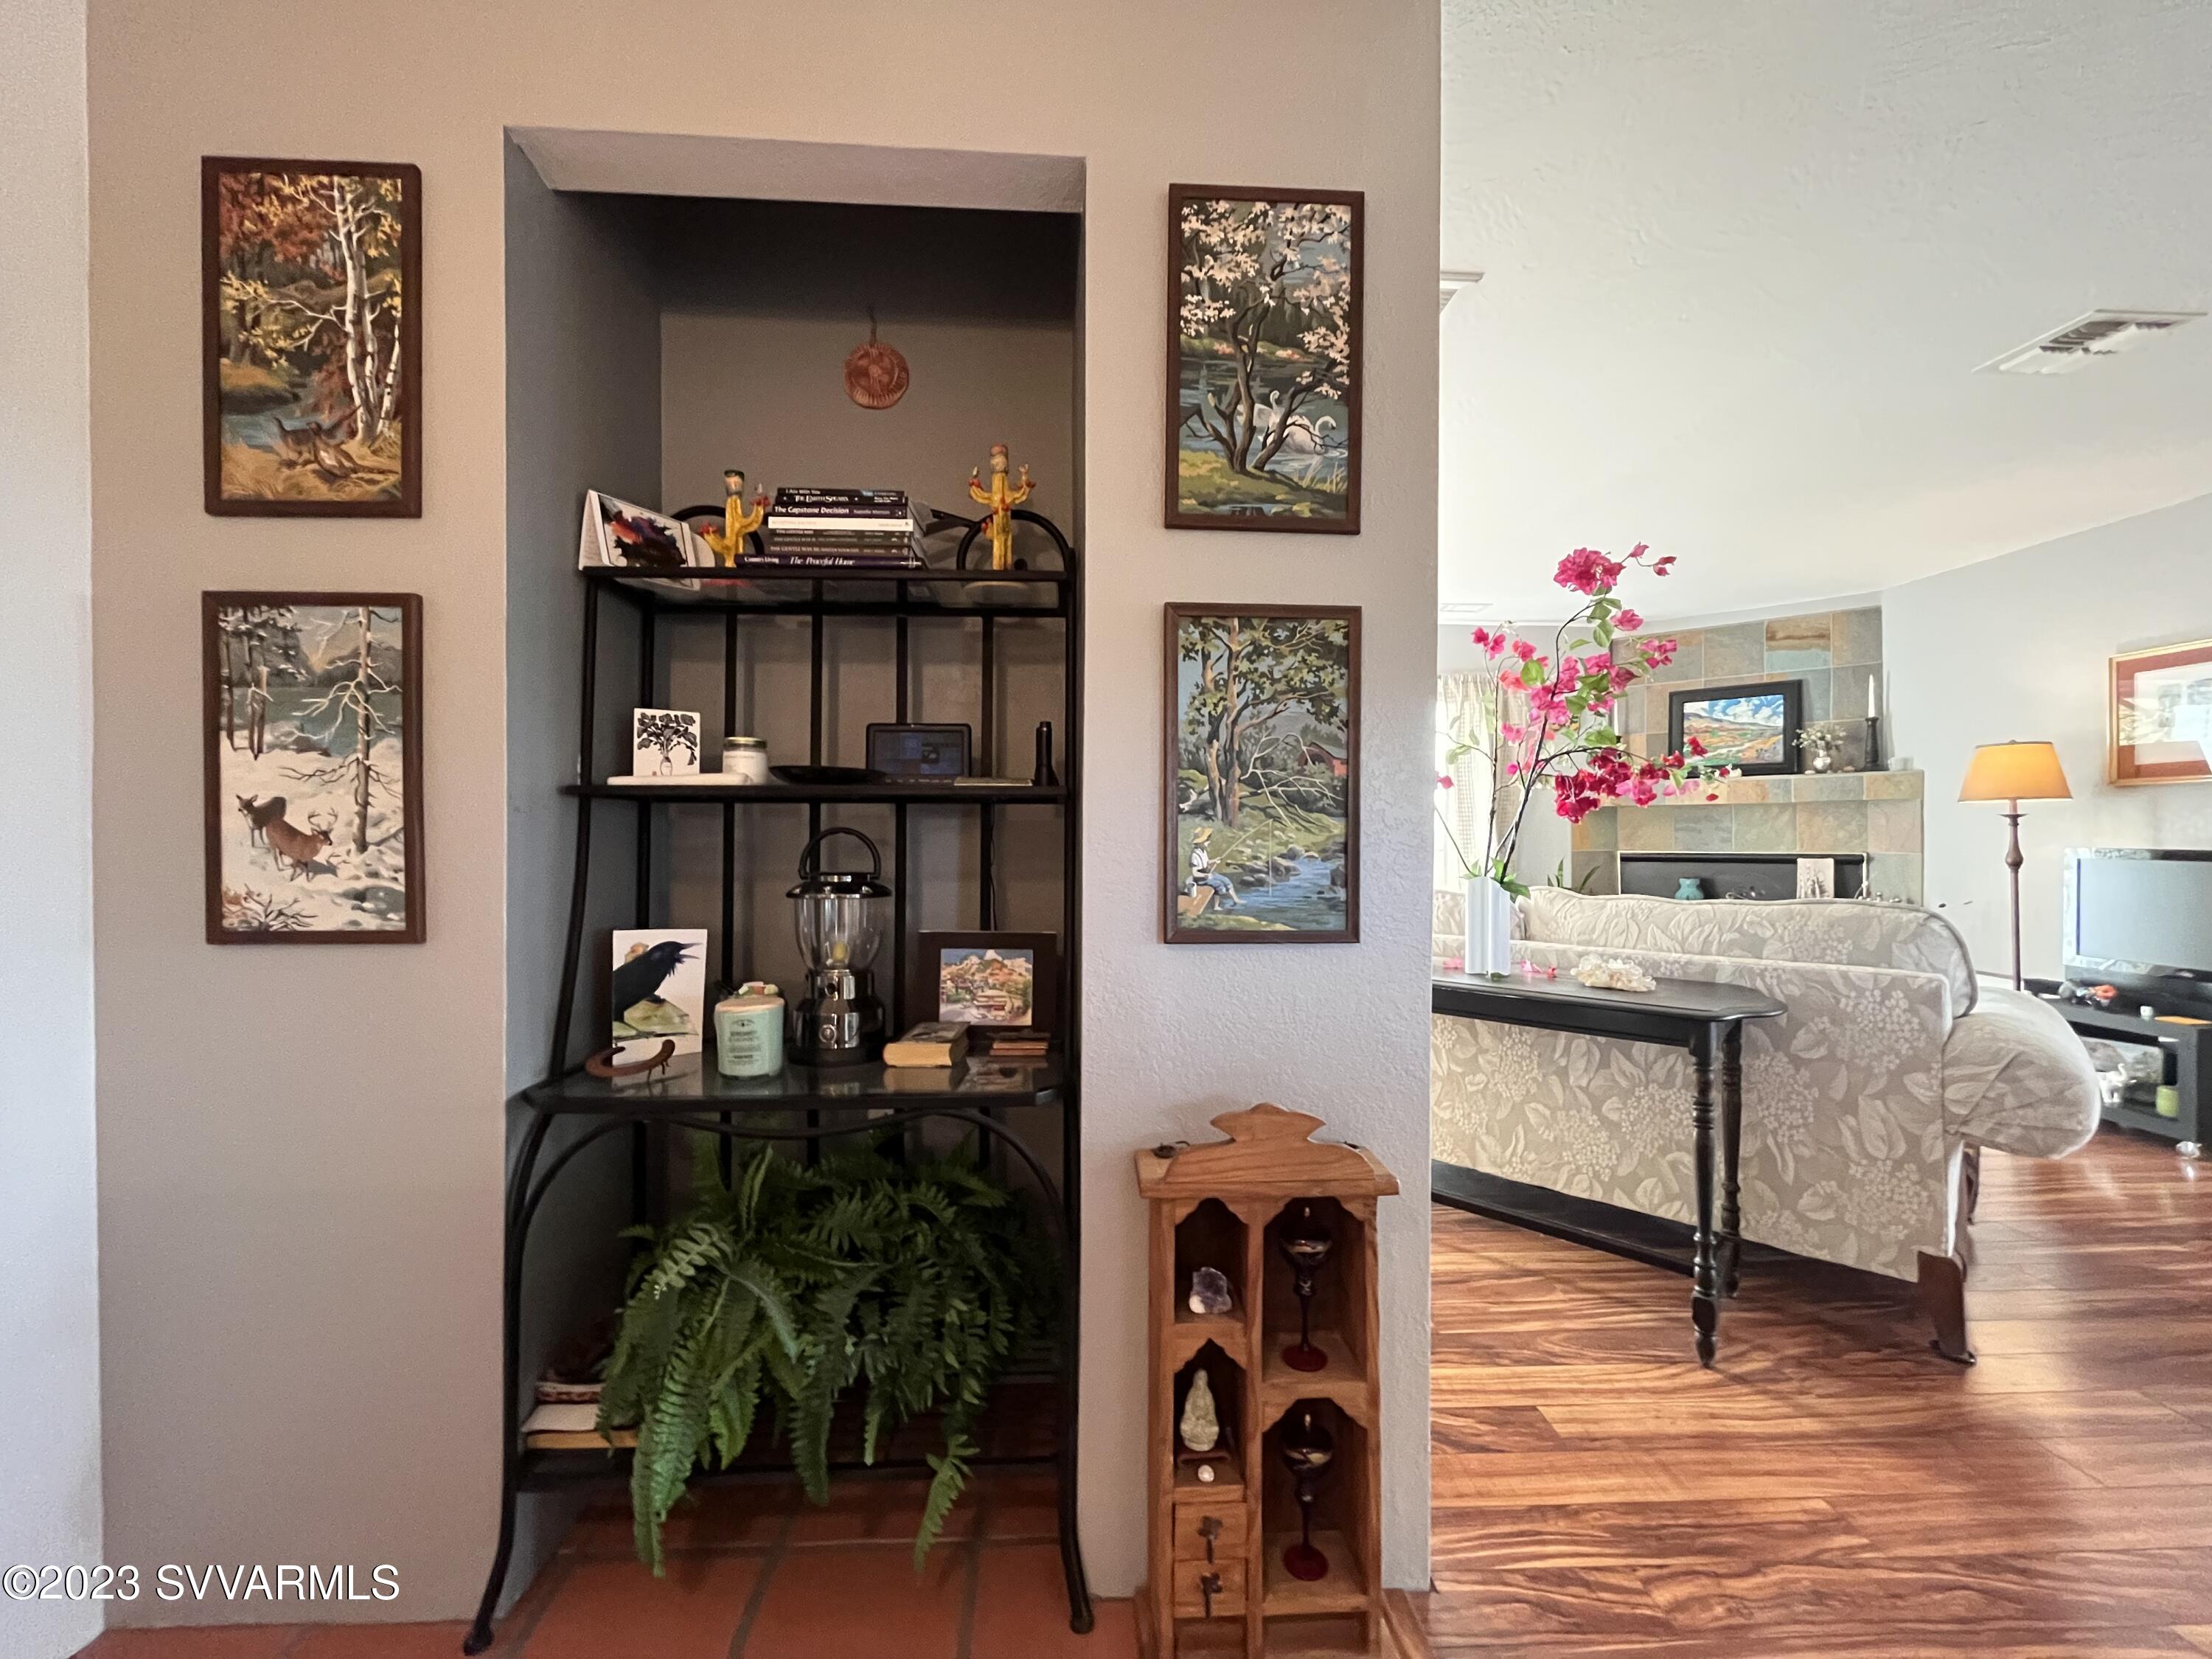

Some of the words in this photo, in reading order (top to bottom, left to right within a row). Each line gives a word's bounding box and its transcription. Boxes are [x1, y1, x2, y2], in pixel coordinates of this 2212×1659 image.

[787, 506, 820, 514] Capstone
[765, 556, 779, 564] Living
[790, 556, 804, 565] The
[805, 557, 834, 566] Peaceful
[835, 557, 856, 566] Home
